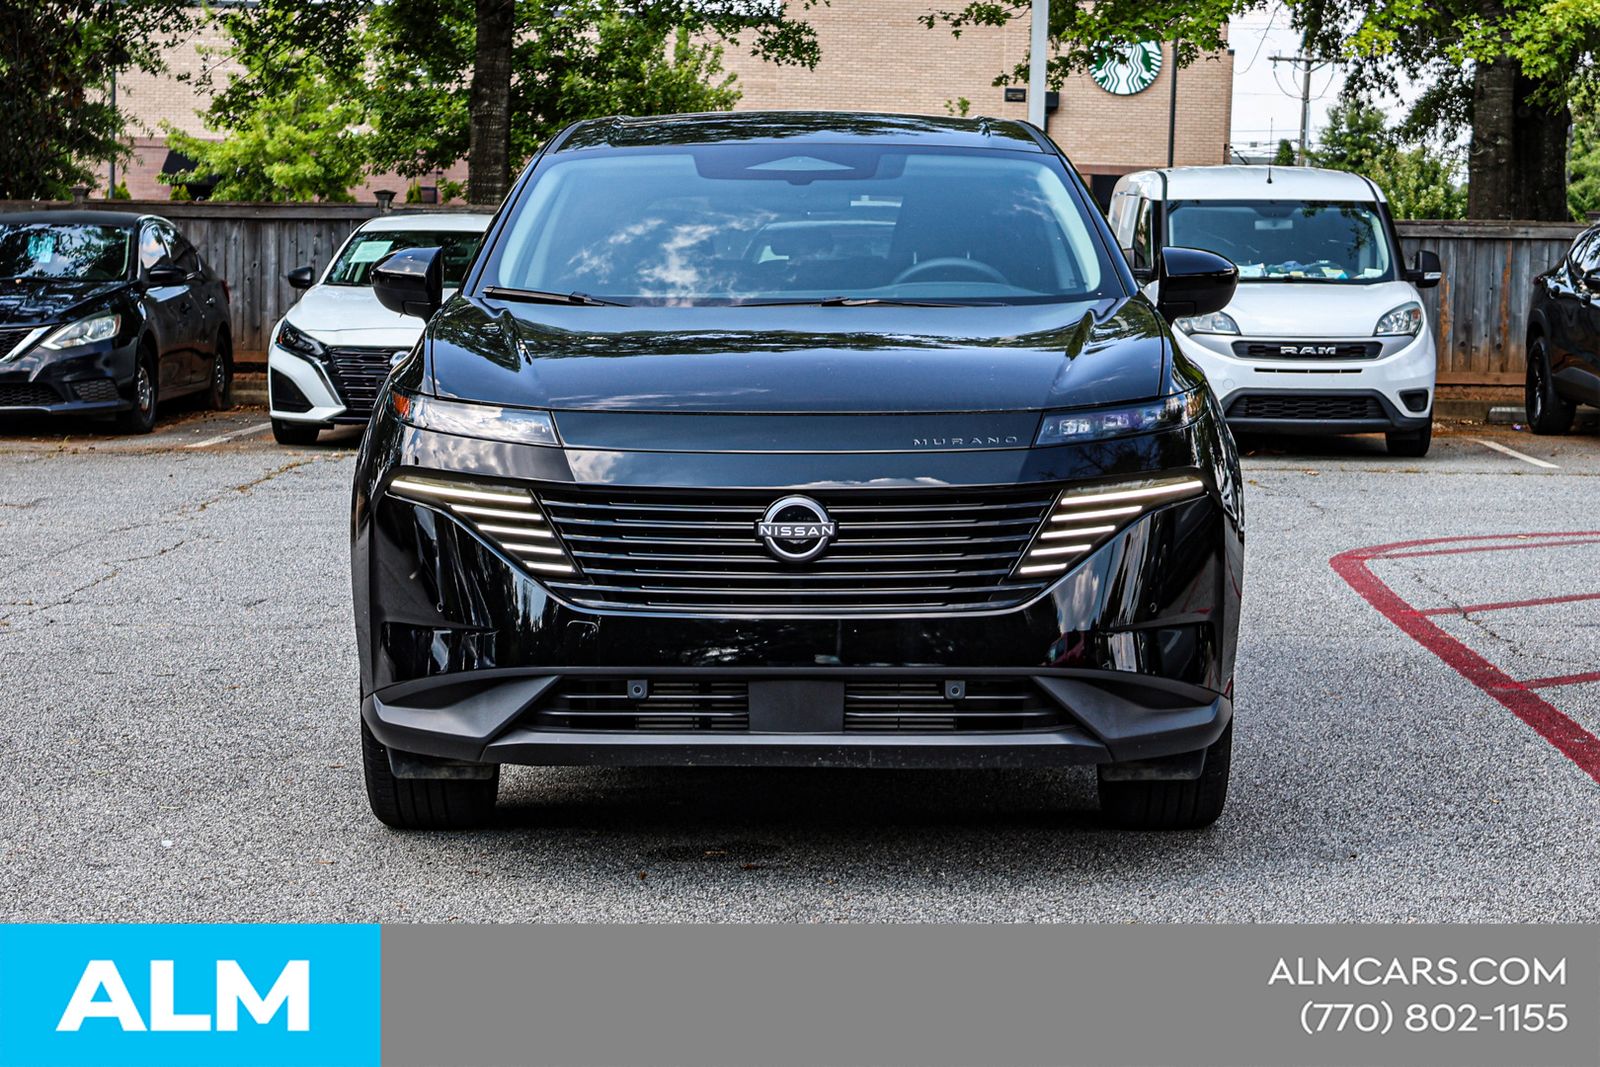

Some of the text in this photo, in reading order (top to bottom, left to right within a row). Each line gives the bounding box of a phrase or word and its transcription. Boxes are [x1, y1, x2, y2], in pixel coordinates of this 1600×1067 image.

[1280, 346, 1337, 355] RAM
[913, 436, 1018, 446] MURANO
[760, 525, 834, 536] NISSAN
